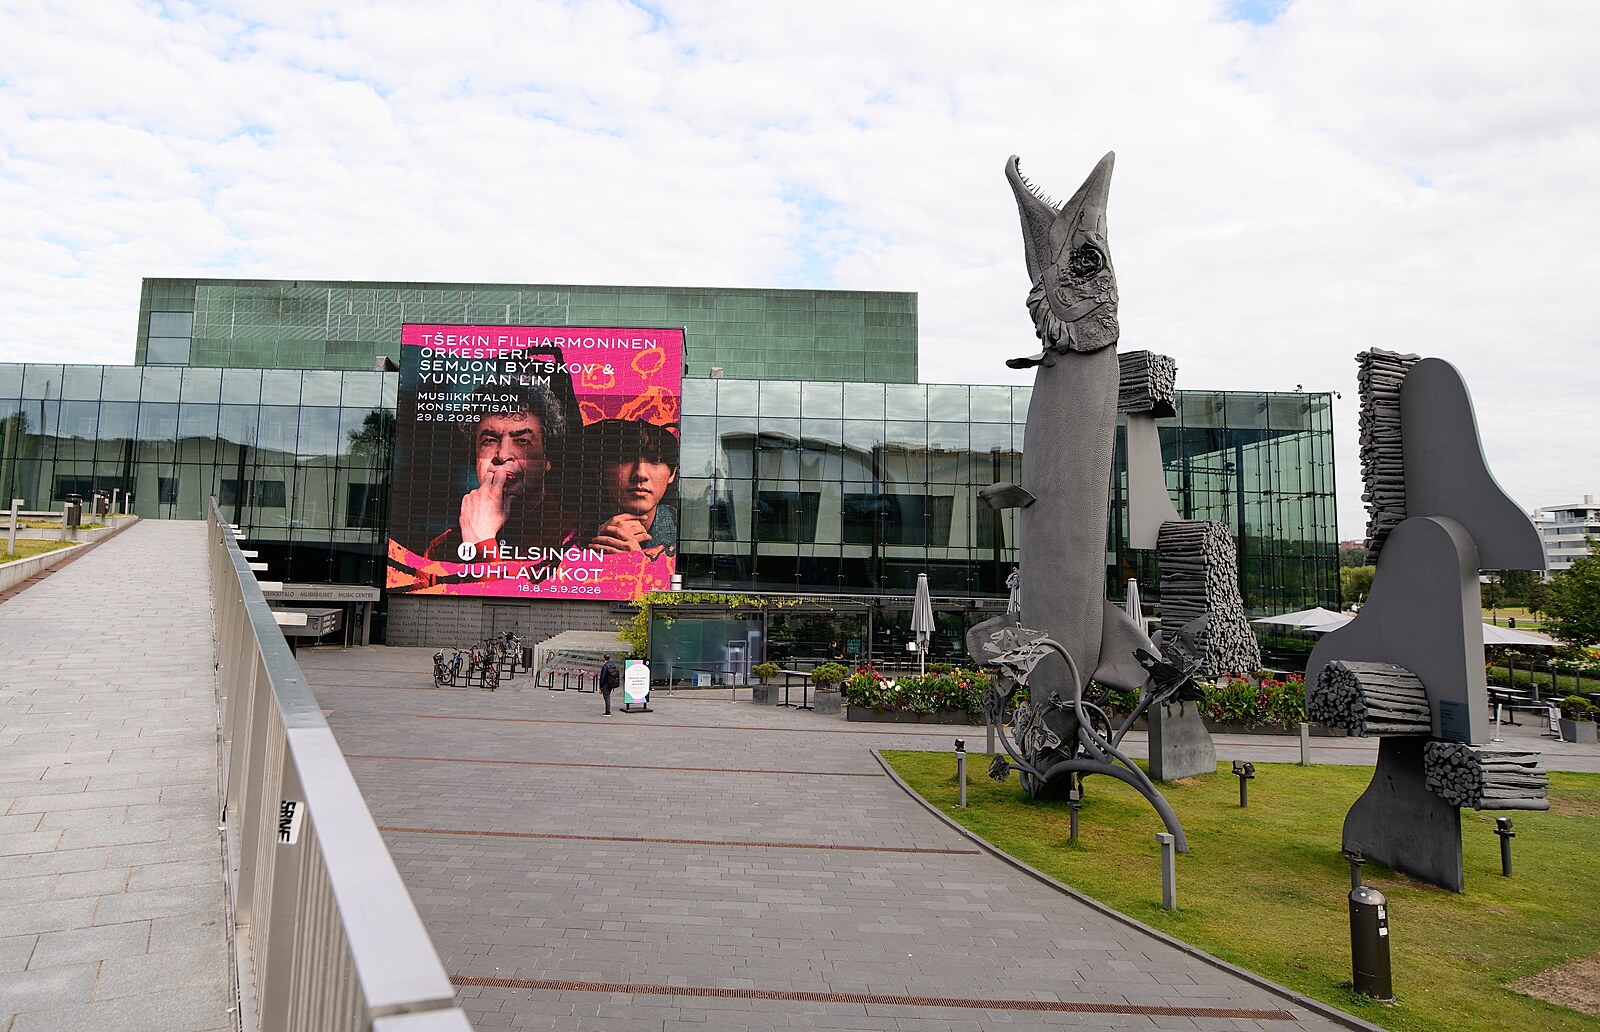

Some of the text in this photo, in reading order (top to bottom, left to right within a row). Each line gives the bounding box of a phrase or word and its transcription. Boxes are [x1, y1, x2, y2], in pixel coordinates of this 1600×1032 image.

[421, 332, 657, 350] TŠEKIN FILHARMONINEN
[420, 347, 534, 362] ORKESTERI,
[419, 360, 615, 375] SEMJON BYTŠKOV &
[419, 372, 551, 386] YUNCHAN LIM
[417, 392, 518, 402] MUSIIKKITALON
[417, 402, 520, 413] KONSERTTISALI
[416, 413, 481, 423] 29.8.2026
[483, 545, 604, 562] HELSINGIN
[457, 564, 604, 582] JUHLAVIIKOT
